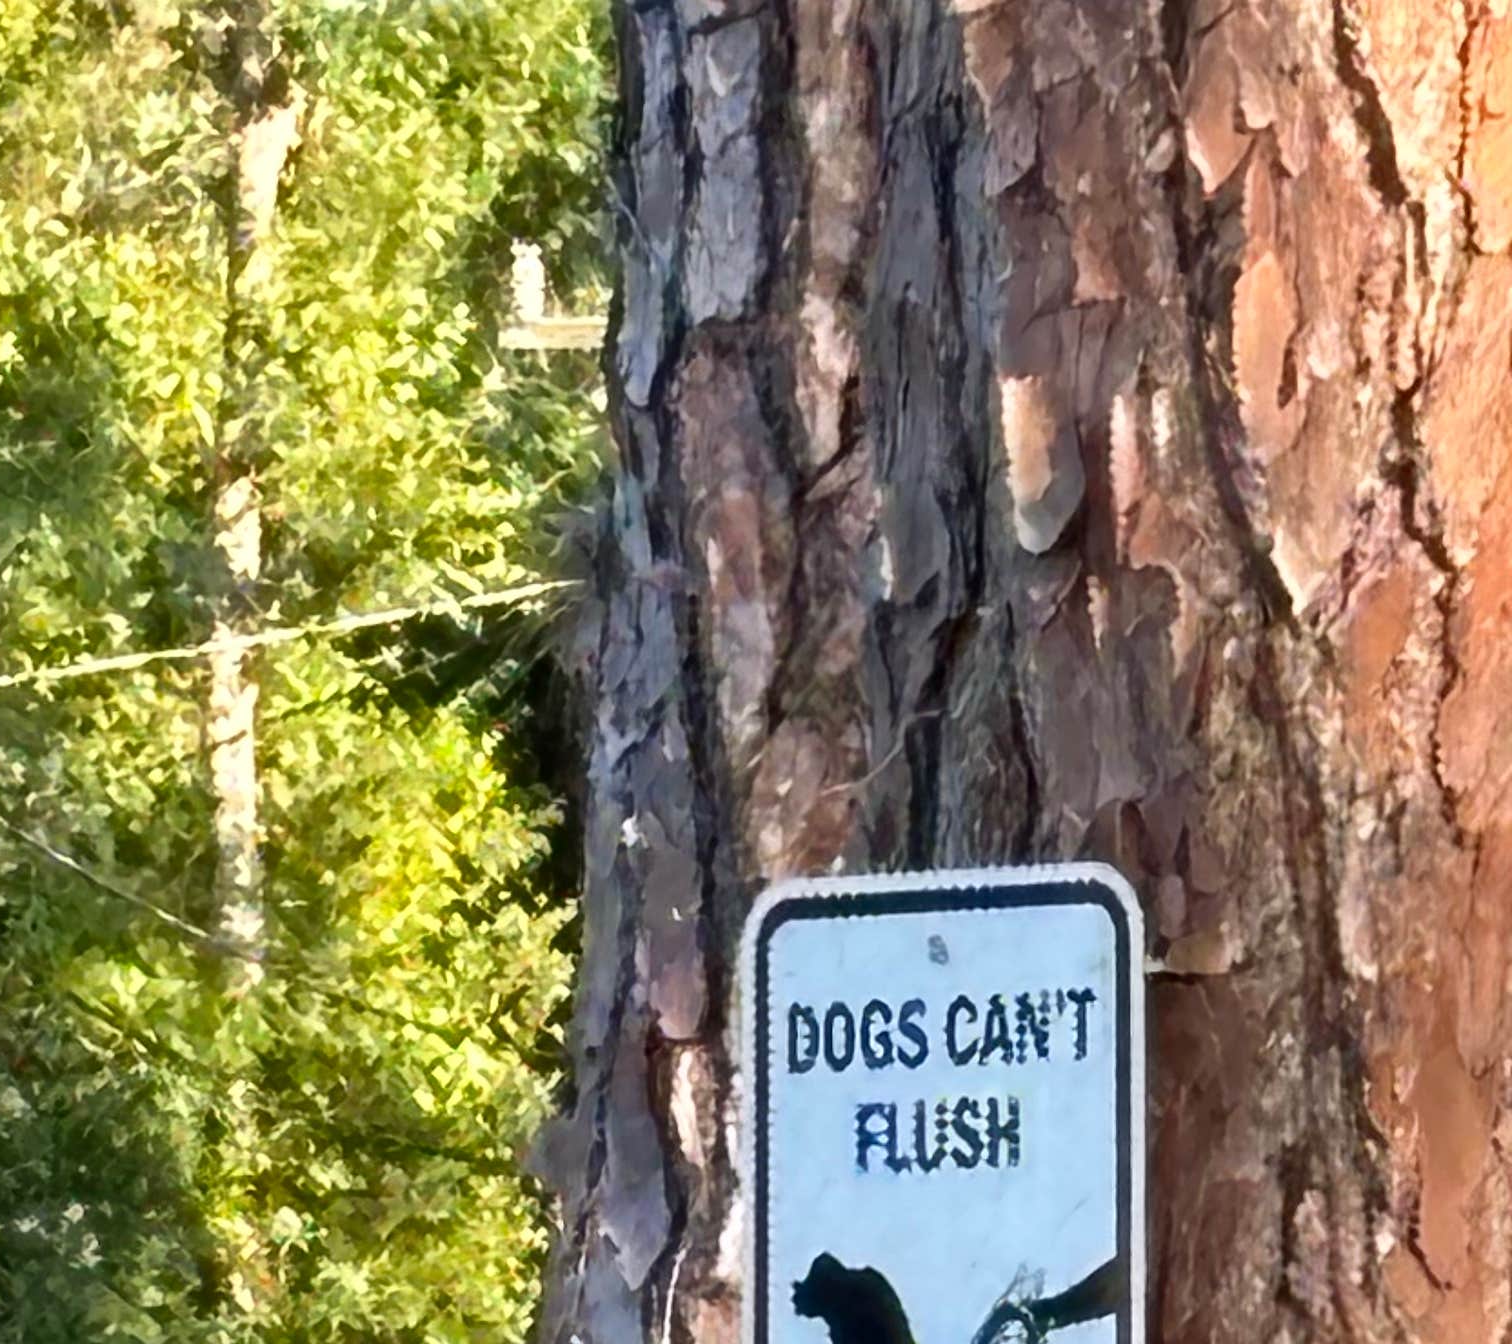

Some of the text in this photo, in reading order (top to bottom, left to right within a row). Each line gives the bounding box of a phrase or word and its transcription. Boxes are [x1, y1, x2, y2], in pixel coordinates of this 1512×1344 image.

[788, 987, 1097, 1074] DOGS CAN'T
[854, 1096, 1020, 1174] FLUSH
